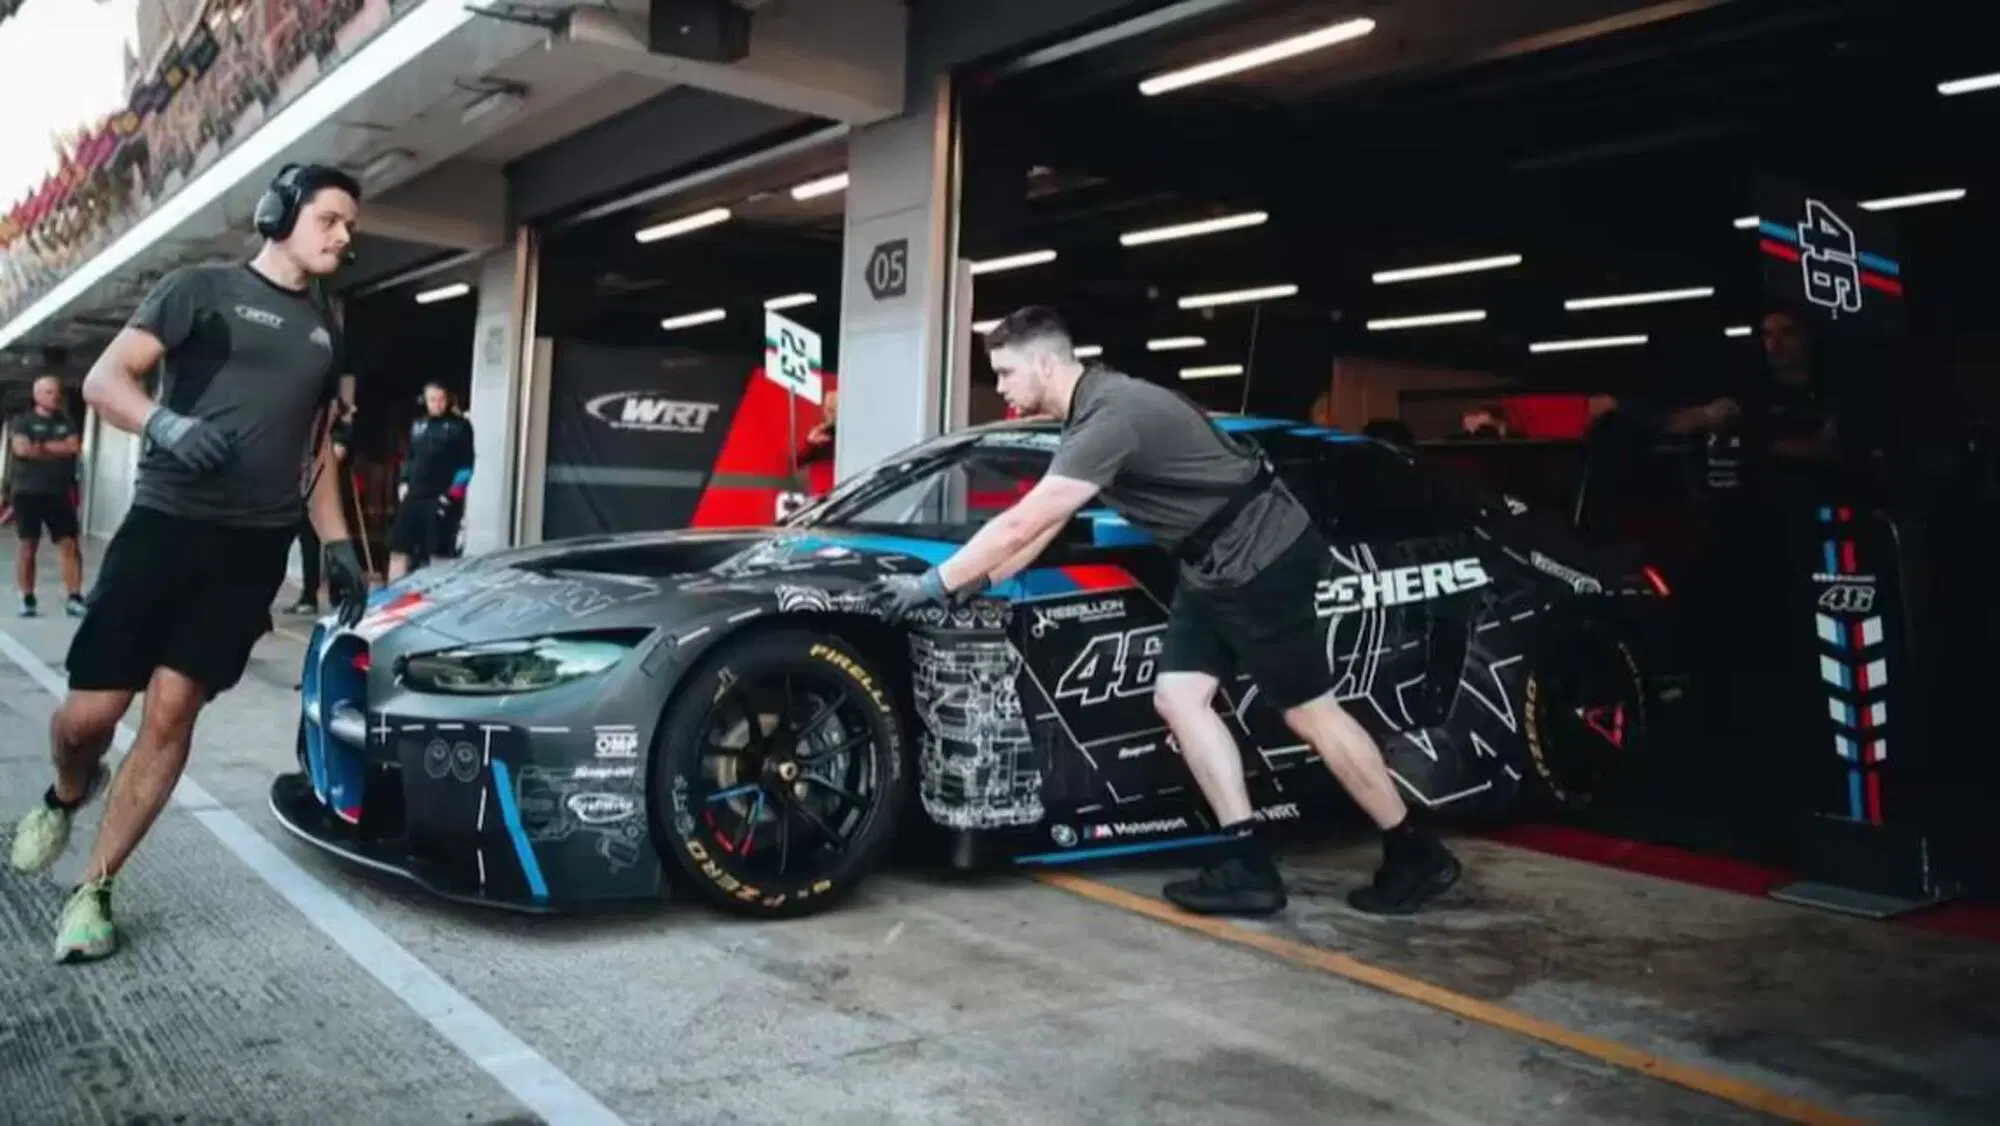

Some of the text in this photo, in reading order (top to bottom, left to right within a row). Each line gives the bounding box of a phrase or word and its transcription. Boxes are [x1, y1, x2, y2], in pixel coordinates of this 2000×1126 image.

[873, 250, 905, 290] 05
[1798, 198, 1862, 313] 46
[620, 398, 720, 427] WRT
[810, 643, 890, 713] PIRELLI
